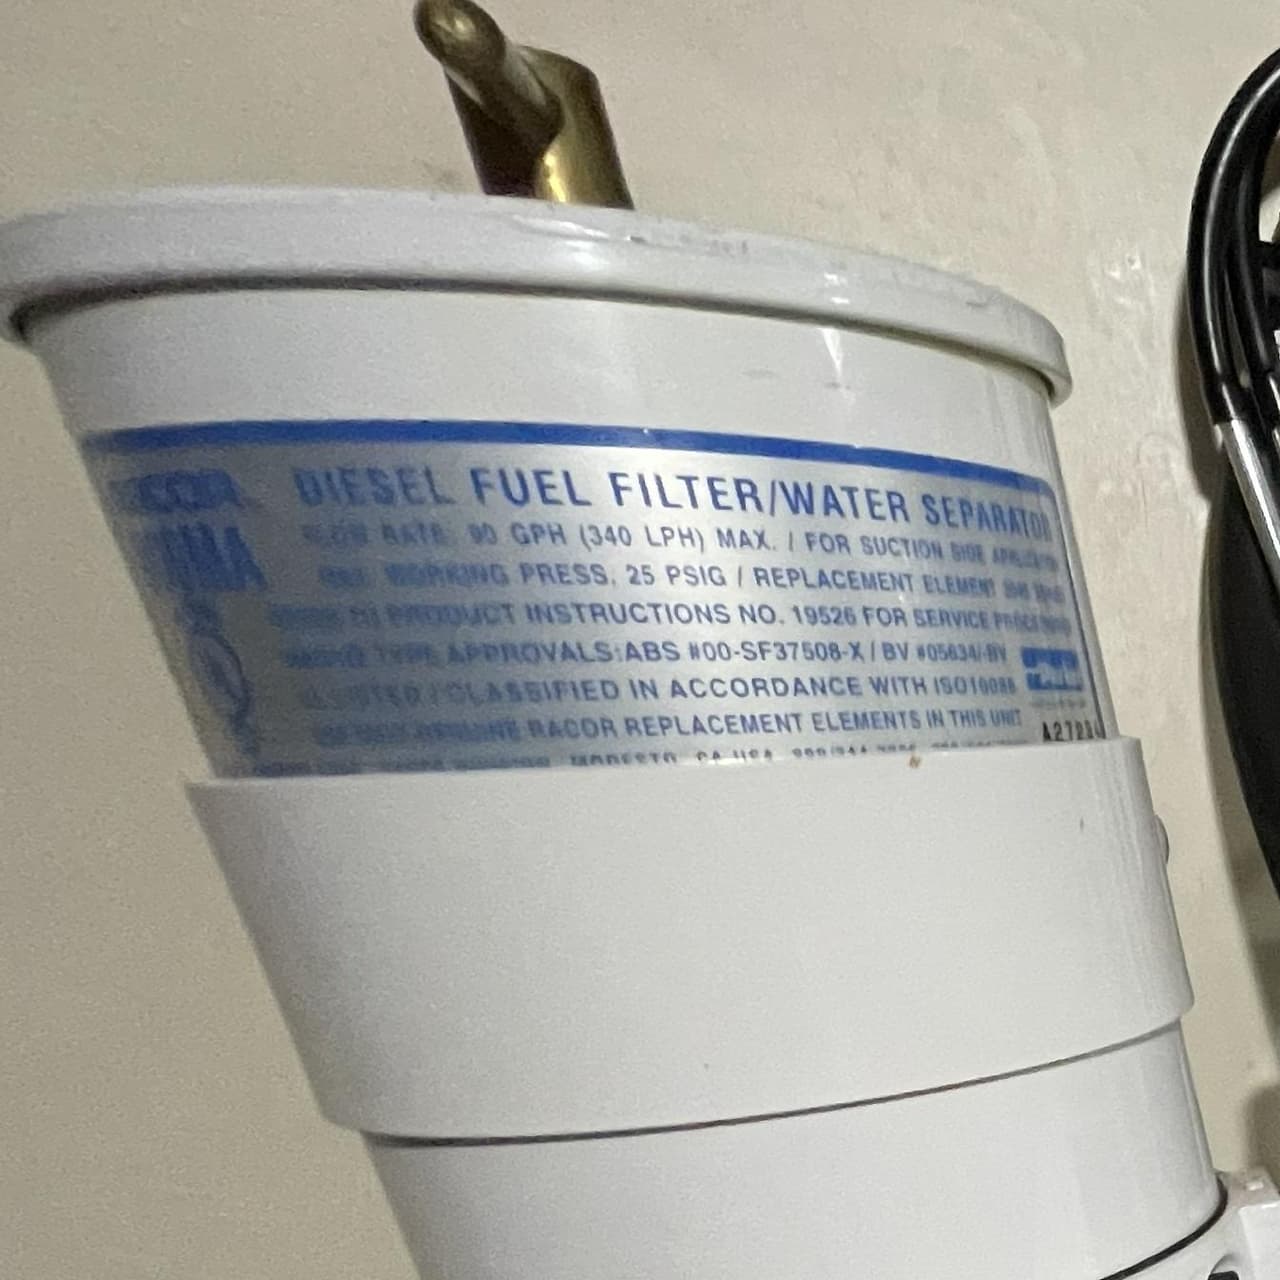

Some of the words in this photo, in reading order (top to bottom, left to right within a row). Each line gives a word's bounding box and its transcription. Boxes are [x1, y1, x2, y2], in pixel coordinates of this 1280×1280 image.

[293, 467, 455, 506] DIESEL
[469, 466, 593, 508] FUEL
[607, 471, 911, 524] FILTER/WATER
[921, 493, 1051, 542] SEPARATOR
[510, 521, 567, 547] GPH
[579, 522, 633, 552] (340
[643, 525, 705, 552] LPH)
[716, 528, 777, 551] MAX.
[804, 532, 851, 555] FOR
[860, 535, 944, 561] SUCTION
[625, 564, 656, 588] 25
[664, 564, 727, 588] PSIG
[752, 565, 915, 594] REPLACEMENT
[922, 572, 996, 600] ELEMENT
[524, 602, 731, 625] INSTRUCTIONS
[738, 603, 785, 625] NO.
[791, 605, 858, 628] 19526
[861, 604, 908, 628] FOR
[913, 606, 989, 631] SERVICE
[880, 642, 909, 663] BV
[628, 678, 659, 701] IN
[670, 676, 863, 700] ACCORDANCE
[867, 675, 928, 698] WITH
[527, 716, 620, 740] RACOR
[623, 712, 803, 739] REPLACEMENT
[811, 708, 922, 733] ELEMENTS
[926, 710, 945, 729] IN
[948, 709, 986, 730] THIS
[989, 708, 1022, 728] UNIT
